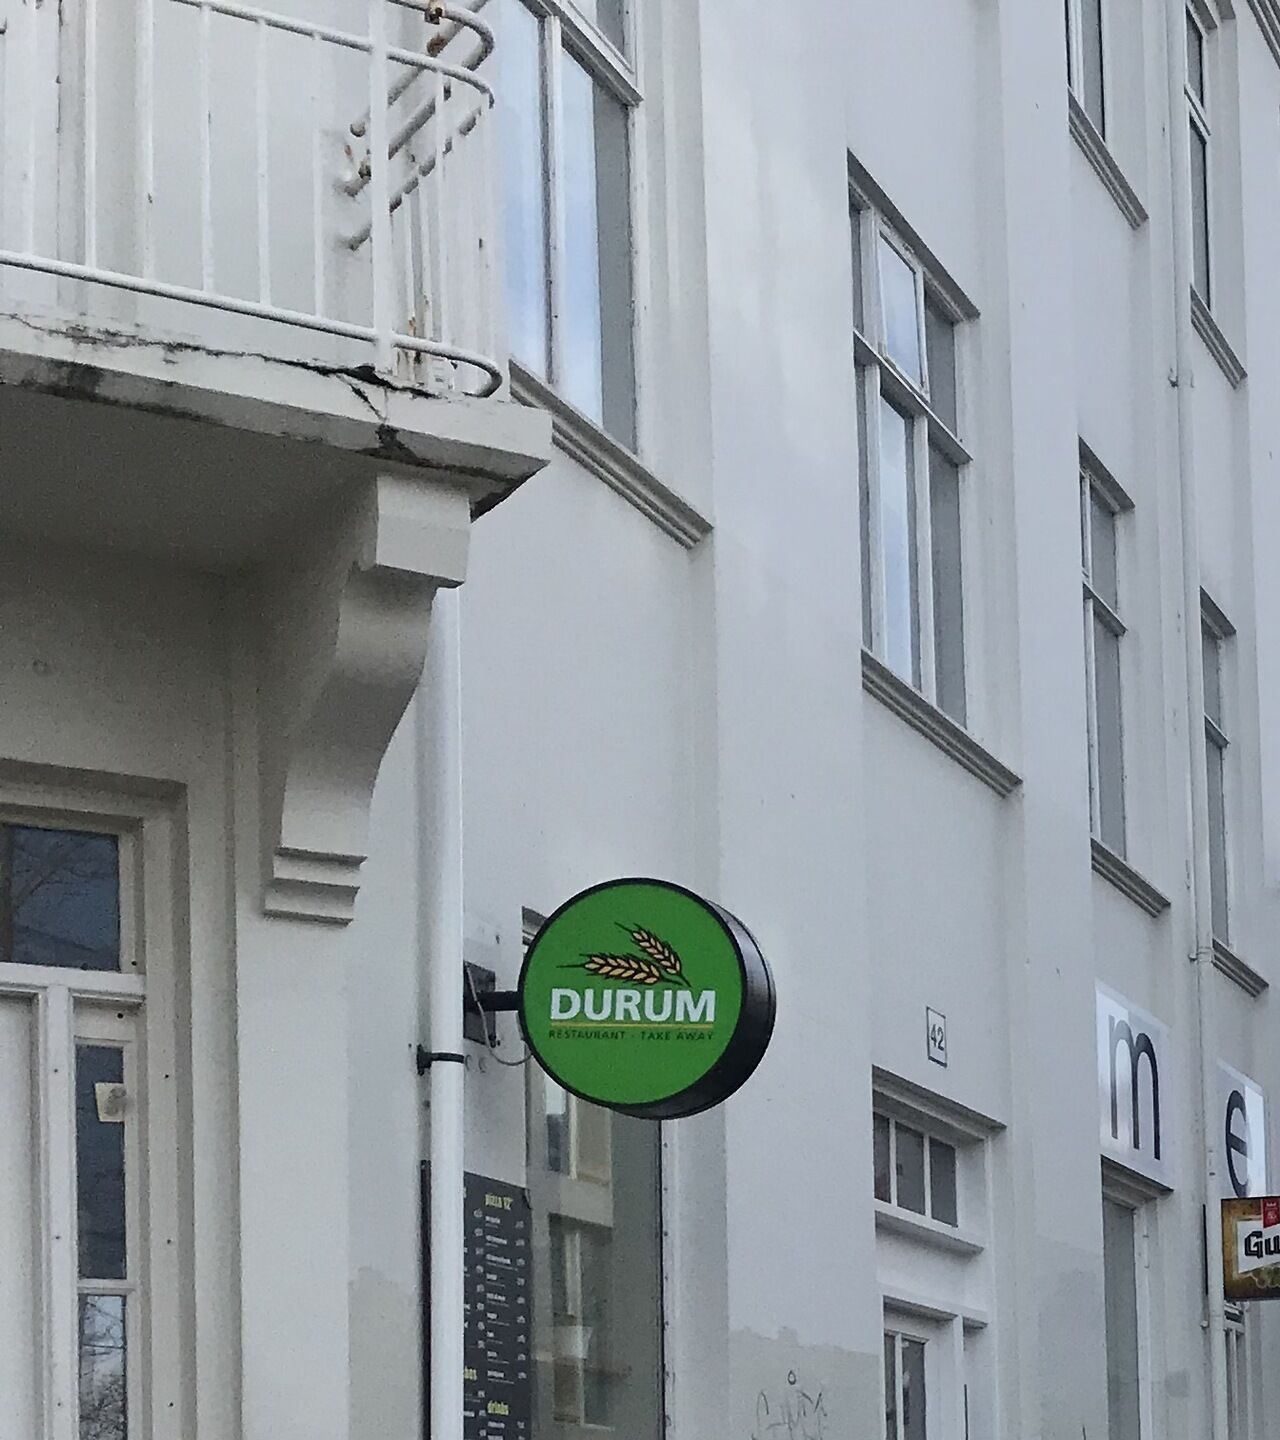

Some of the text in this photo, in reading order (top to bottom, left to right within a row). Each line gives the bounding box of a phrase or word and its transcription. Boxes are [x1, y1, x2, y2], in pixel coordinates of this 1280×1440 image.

[550, 988, 716, 1023] DURUM
[548, 1028, 714, 1040] RESTAURANT TAKE AWAY
[930, 1024, 944, 1051] 42
